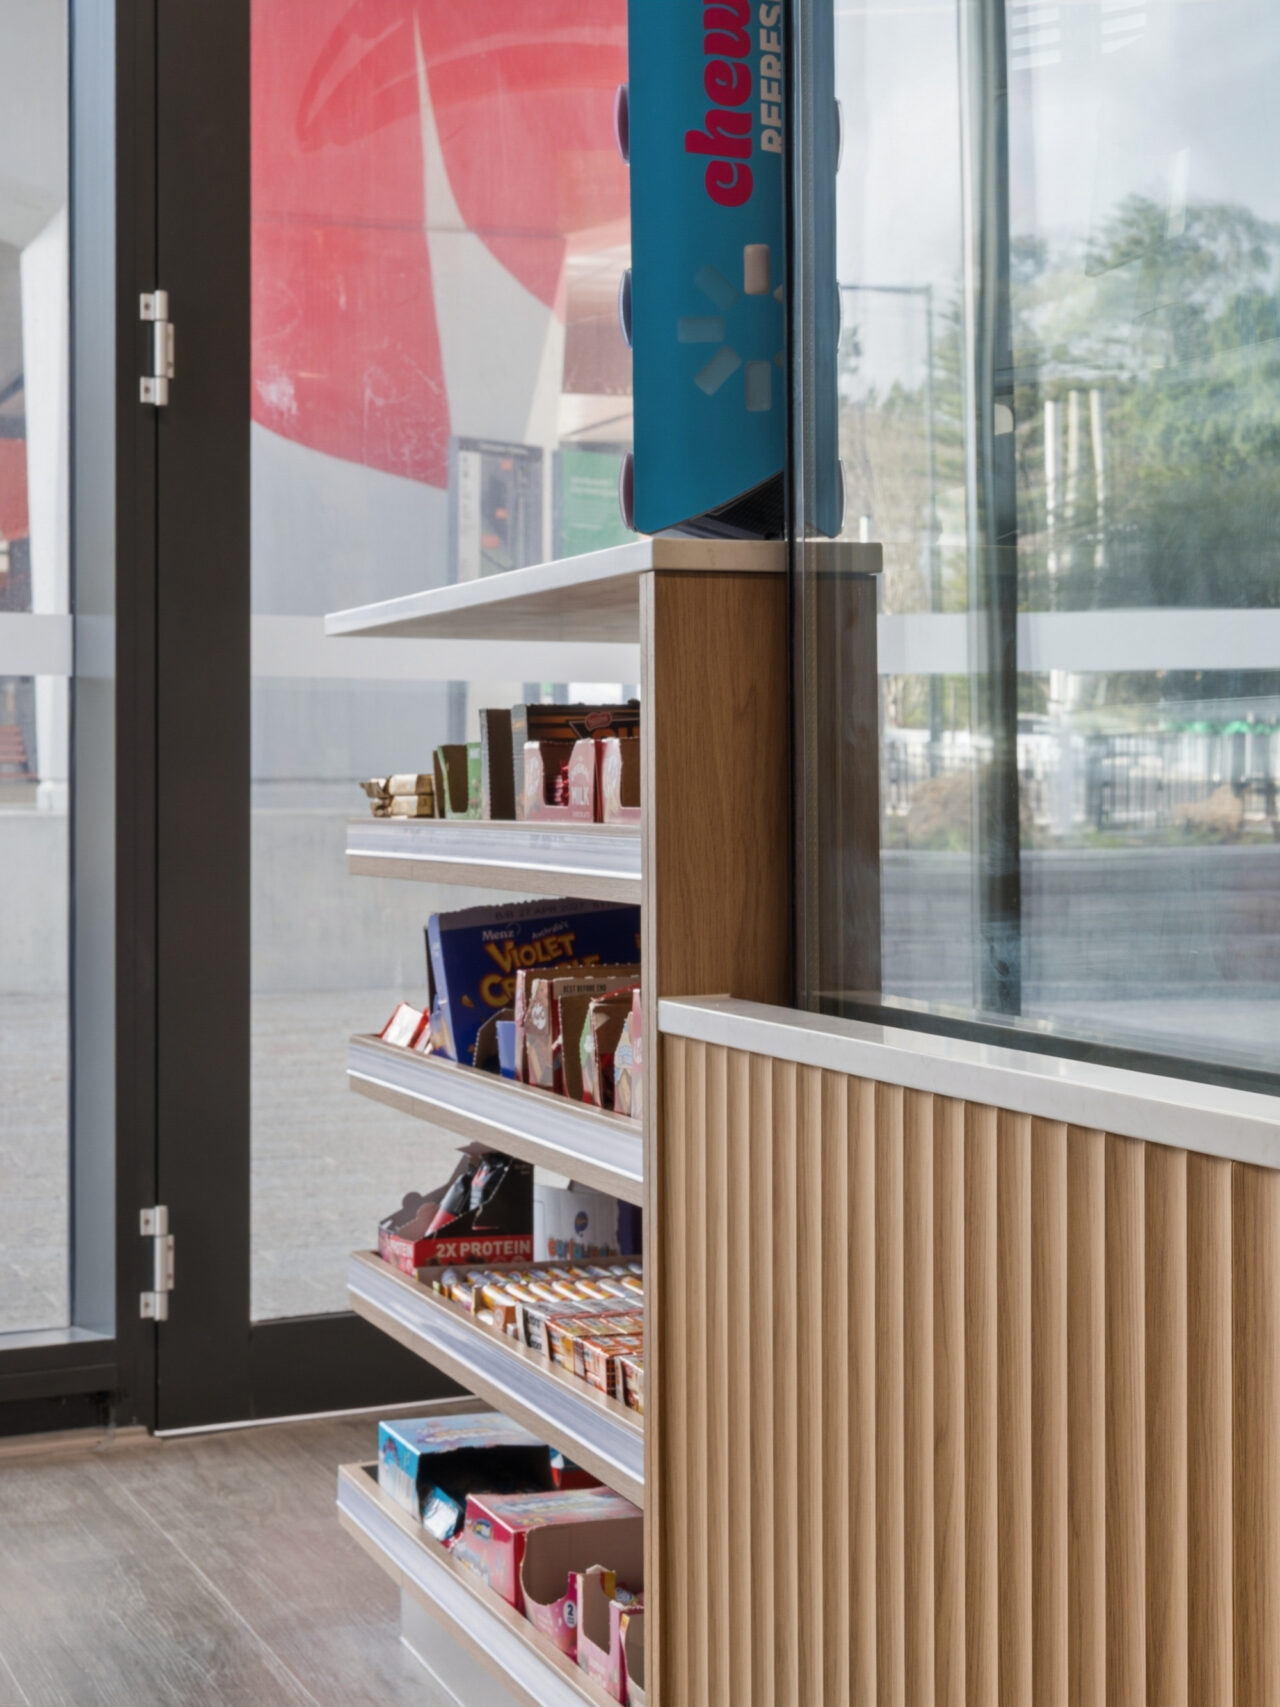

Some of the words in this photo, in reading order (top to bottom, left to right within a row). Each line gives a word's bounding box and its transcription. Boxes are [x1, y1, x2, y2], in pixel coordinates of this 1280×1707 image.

[482, 929, 515, 942] Menz
[436, 1243, 457, 1259] 2X
[459, 1239, 532, 1258] PROTEIN
